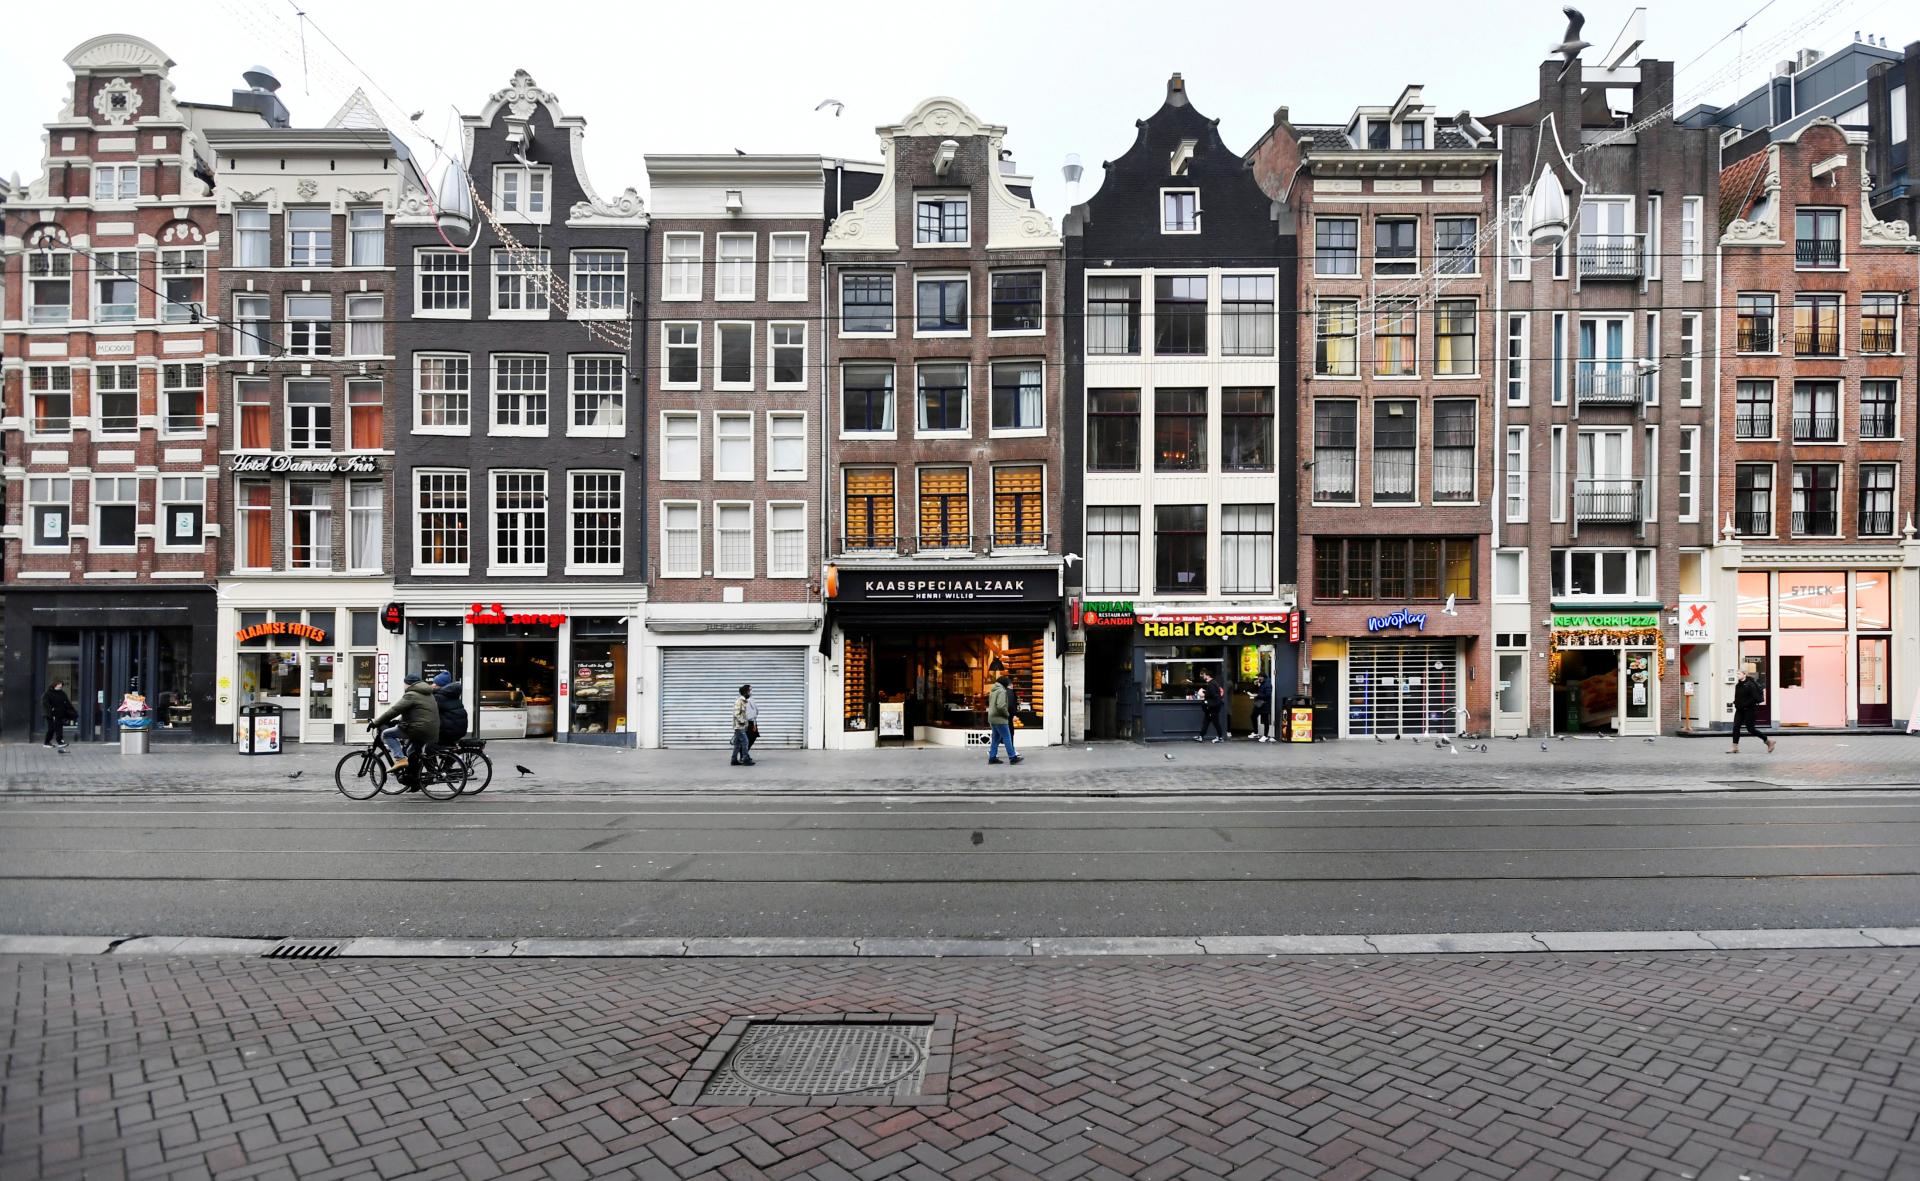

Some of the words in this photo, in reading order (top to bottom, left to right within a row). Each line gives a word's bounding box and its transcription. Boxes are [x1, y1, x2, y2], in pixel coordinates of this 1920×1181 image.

[228, 454, 268, 472] Hotel
[271, 455, 337, 472] Damrak
[338, 456, 375, 472] Inn
[865, 581, 1024, 591] KAASSPECIAALZAAK
[1791, 585, 1833, 596] STOCK
[1083, 601, 1134, 612] INDIAN
[1368, 608, 1426, 631] novoplay
[1554, 616, 1585, 627] NEW
[1586, 616, 1619, 627] YORK
[1620, 616, 1658, 627] PIZZA
[235, 622, 286, 642] VLAAMSE
[287, 623, 327, 642] FRITES
[1144, 622, 1189, 637] Halal
[1195, 622, 1237, 637] Food
[1684, 629, 1708, 637] HOTEL
